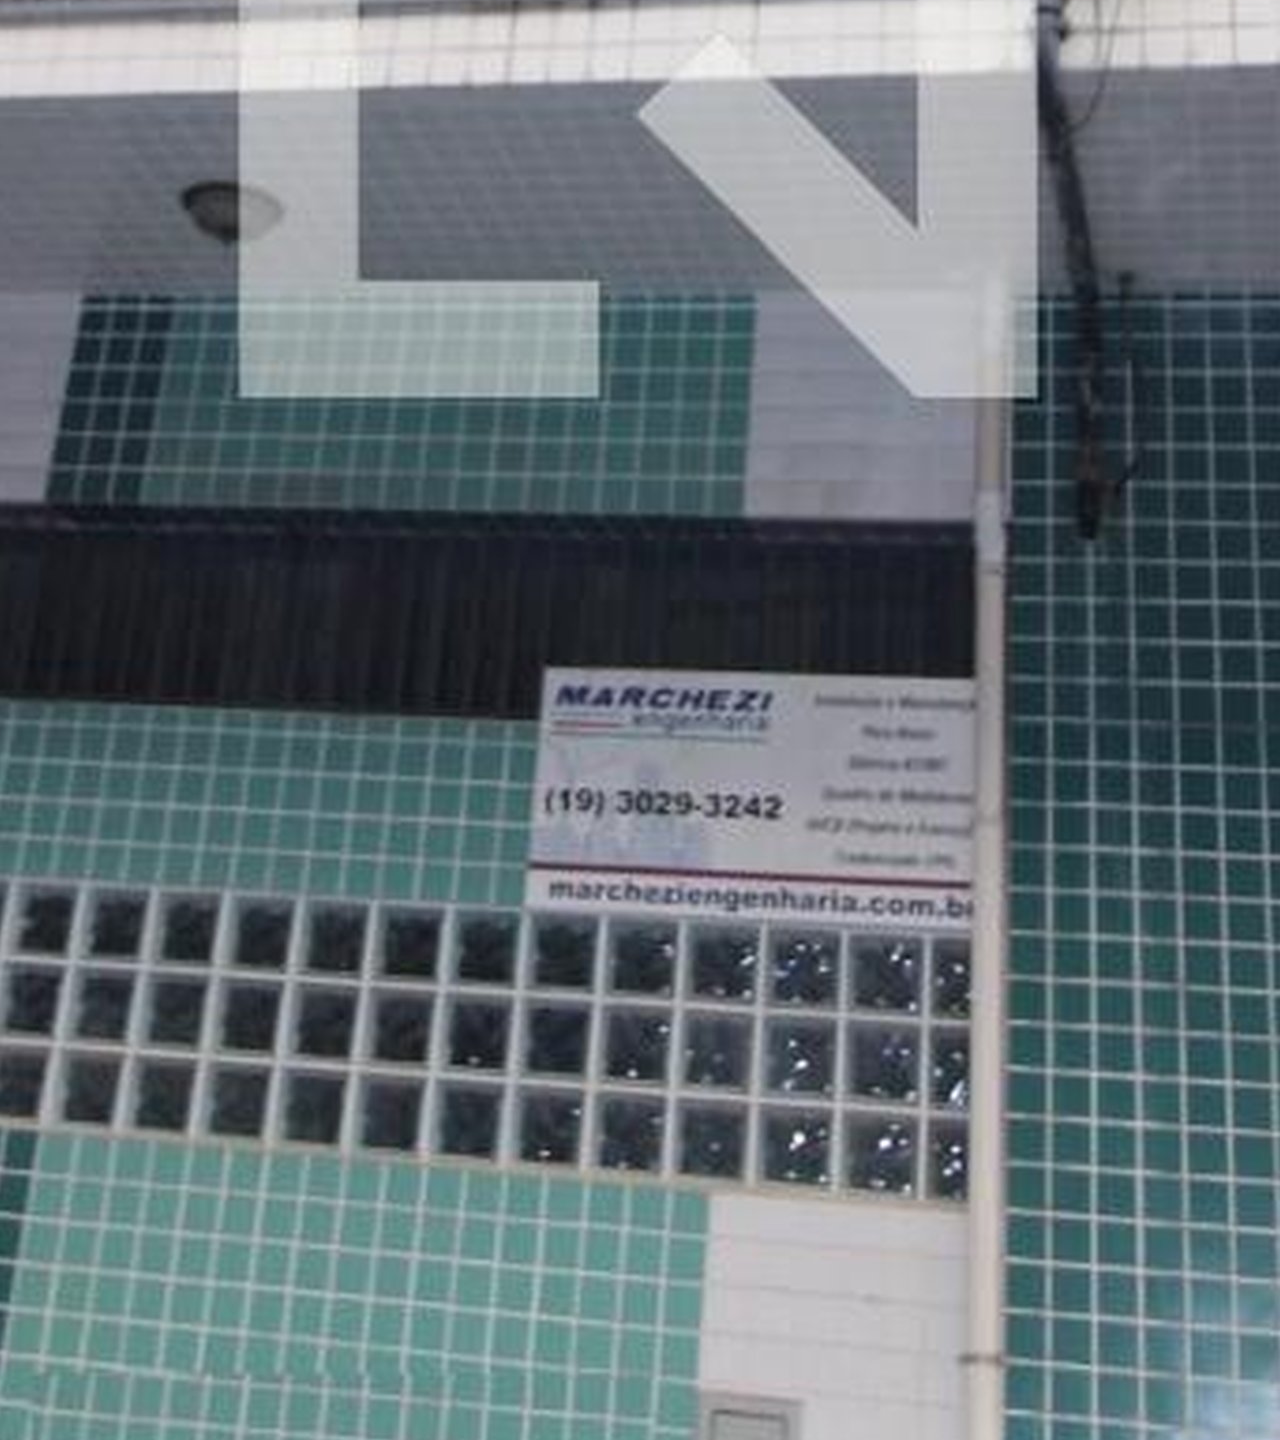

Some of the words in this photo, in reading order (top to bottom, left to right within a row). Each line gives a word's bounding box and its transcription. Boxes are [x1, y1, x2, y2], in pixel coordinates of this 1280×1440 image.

[554, 682, 774, 712] MARCHEZI
[543, 787, 605, 817] (19)
[614, 790, 786, 820] 3029-3242
